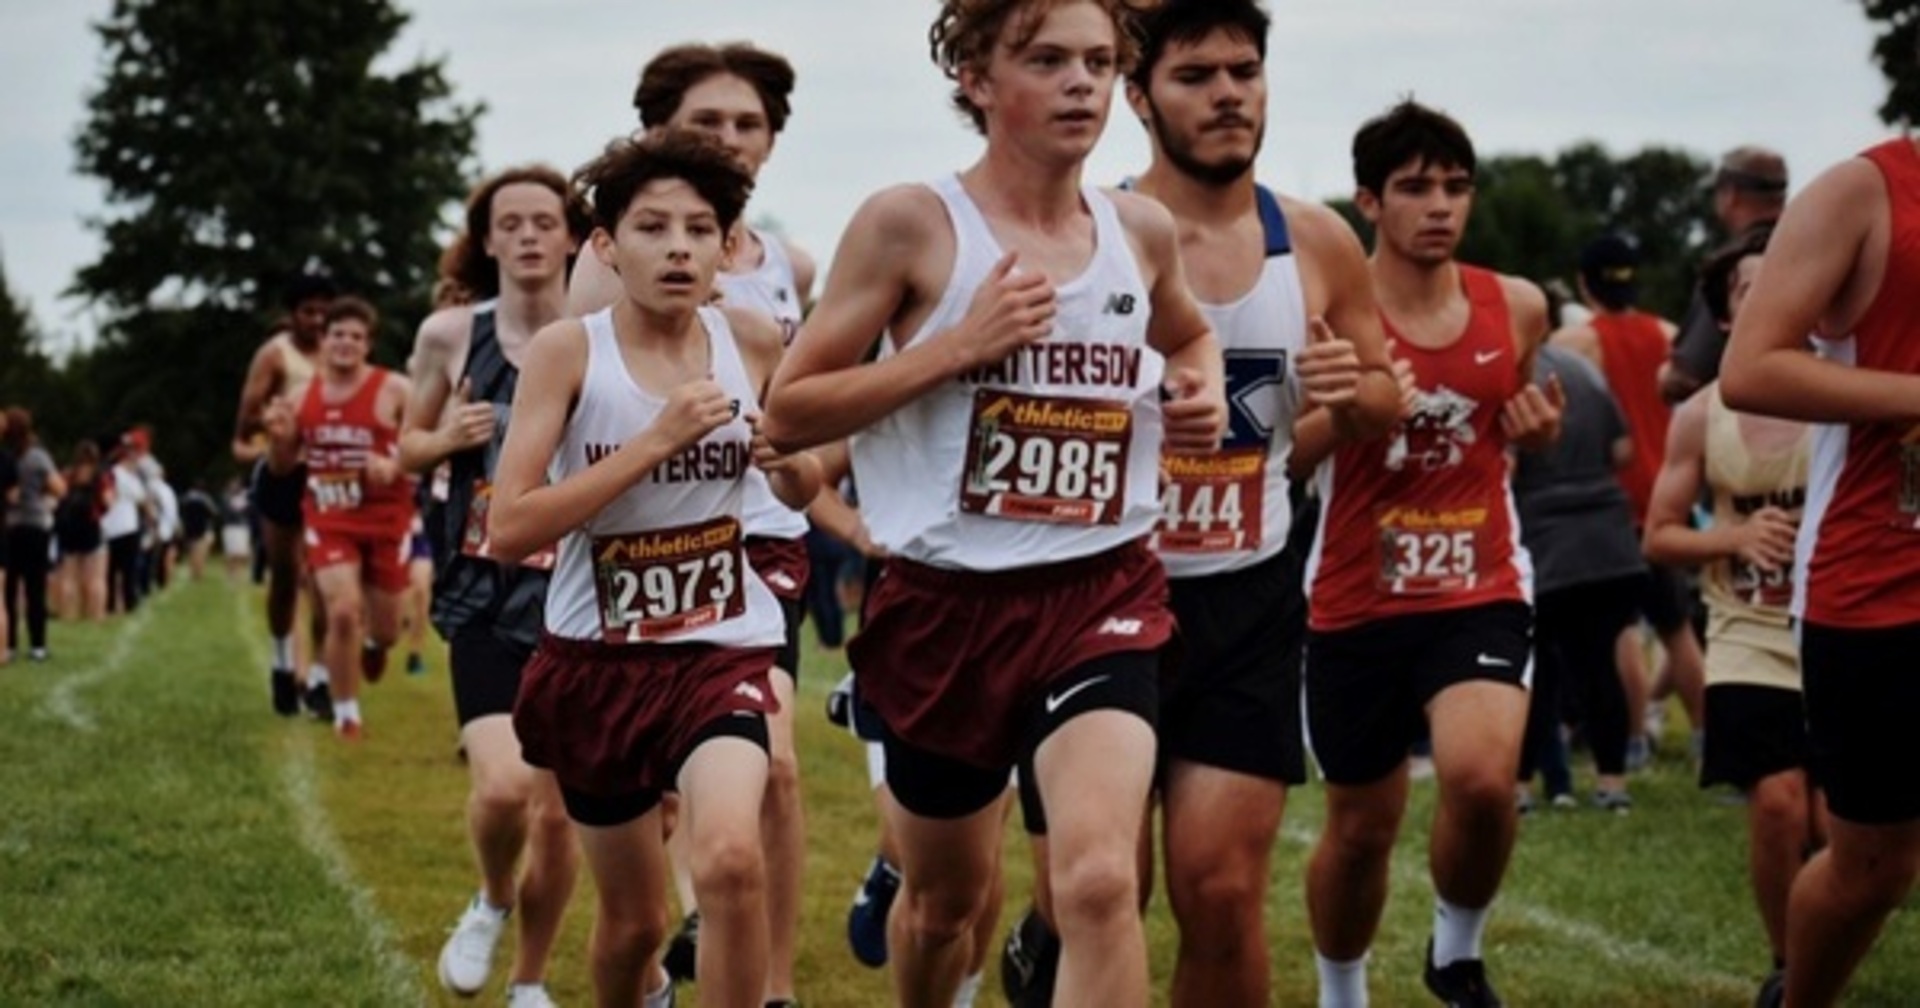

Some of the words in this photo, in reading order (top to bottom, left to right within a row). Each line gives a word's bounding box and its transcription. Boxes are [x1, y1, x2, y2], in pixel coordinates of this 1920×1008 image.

[1103, 294, 1136, 315] NB
[985, 432, 1121, 501] 2985
[1159, 482, 1243, 532] 444
[1396, 531, 1475, 577] 325
[613, 550, 734, 620] 2973
